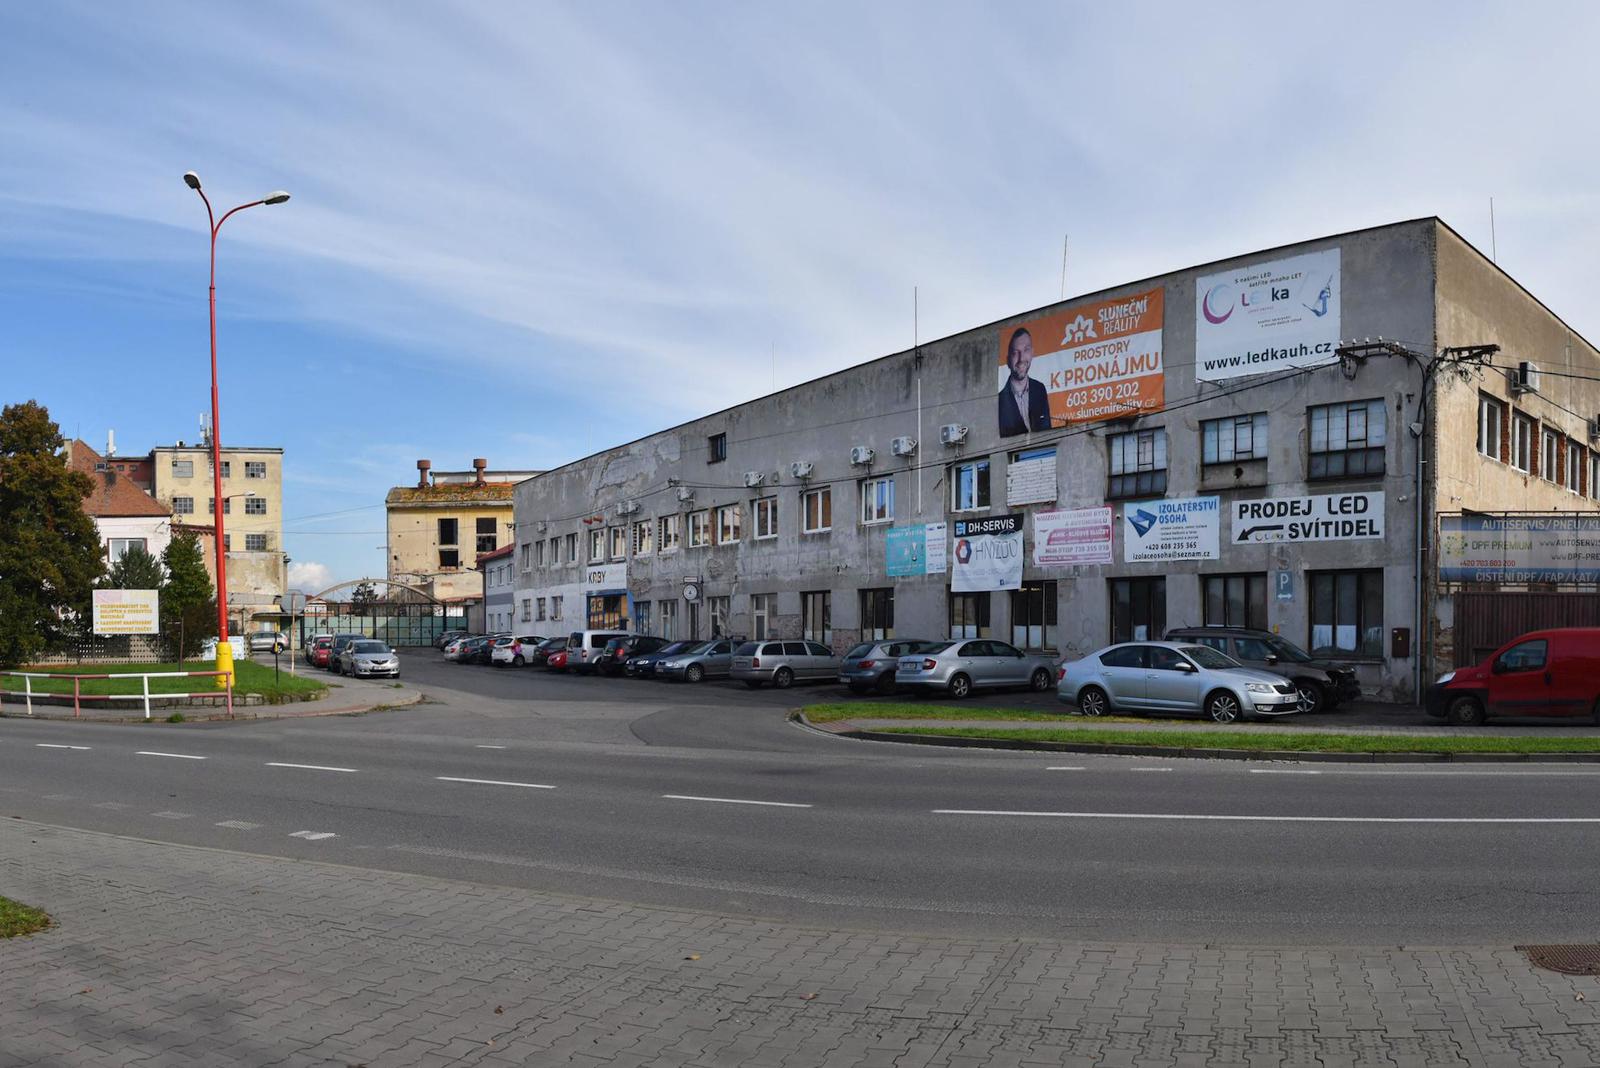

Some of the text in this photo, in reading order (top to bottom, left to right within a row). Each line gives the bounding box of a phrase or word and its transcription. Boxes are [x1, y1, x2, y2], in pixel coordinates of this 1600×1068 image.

[1260, 272, 1272, 280] LED
[1291, 272, 1302, 280] LET
[1098, 296, 1149, 322] SLUNEČNÍ
[1104, 315, 1141, 335] REALITY
[1074, 339, 1131, 362] PROSTORY
[1204, 342, 1332, 371] www.ledkauh.cz
[1050, 352, 1159, 389] K PRONÁJMU
[1066, 381, 1140, 408] 603 390 202
[1239, 495, 1369, 519] PRODEJ LED
[968, 518, 1015, 534] DH-SERVIS
[1159, 513, 1187, 524] OSOHA
[1288, 518, 1380, 539] SVÍTIDEL
[1132, 550, 1210, 561] izolaceosoha@seznam.cz
[1472, 540, 1533, 551] DPF PREMIUM
[1280, 573, 1289, 590] P
